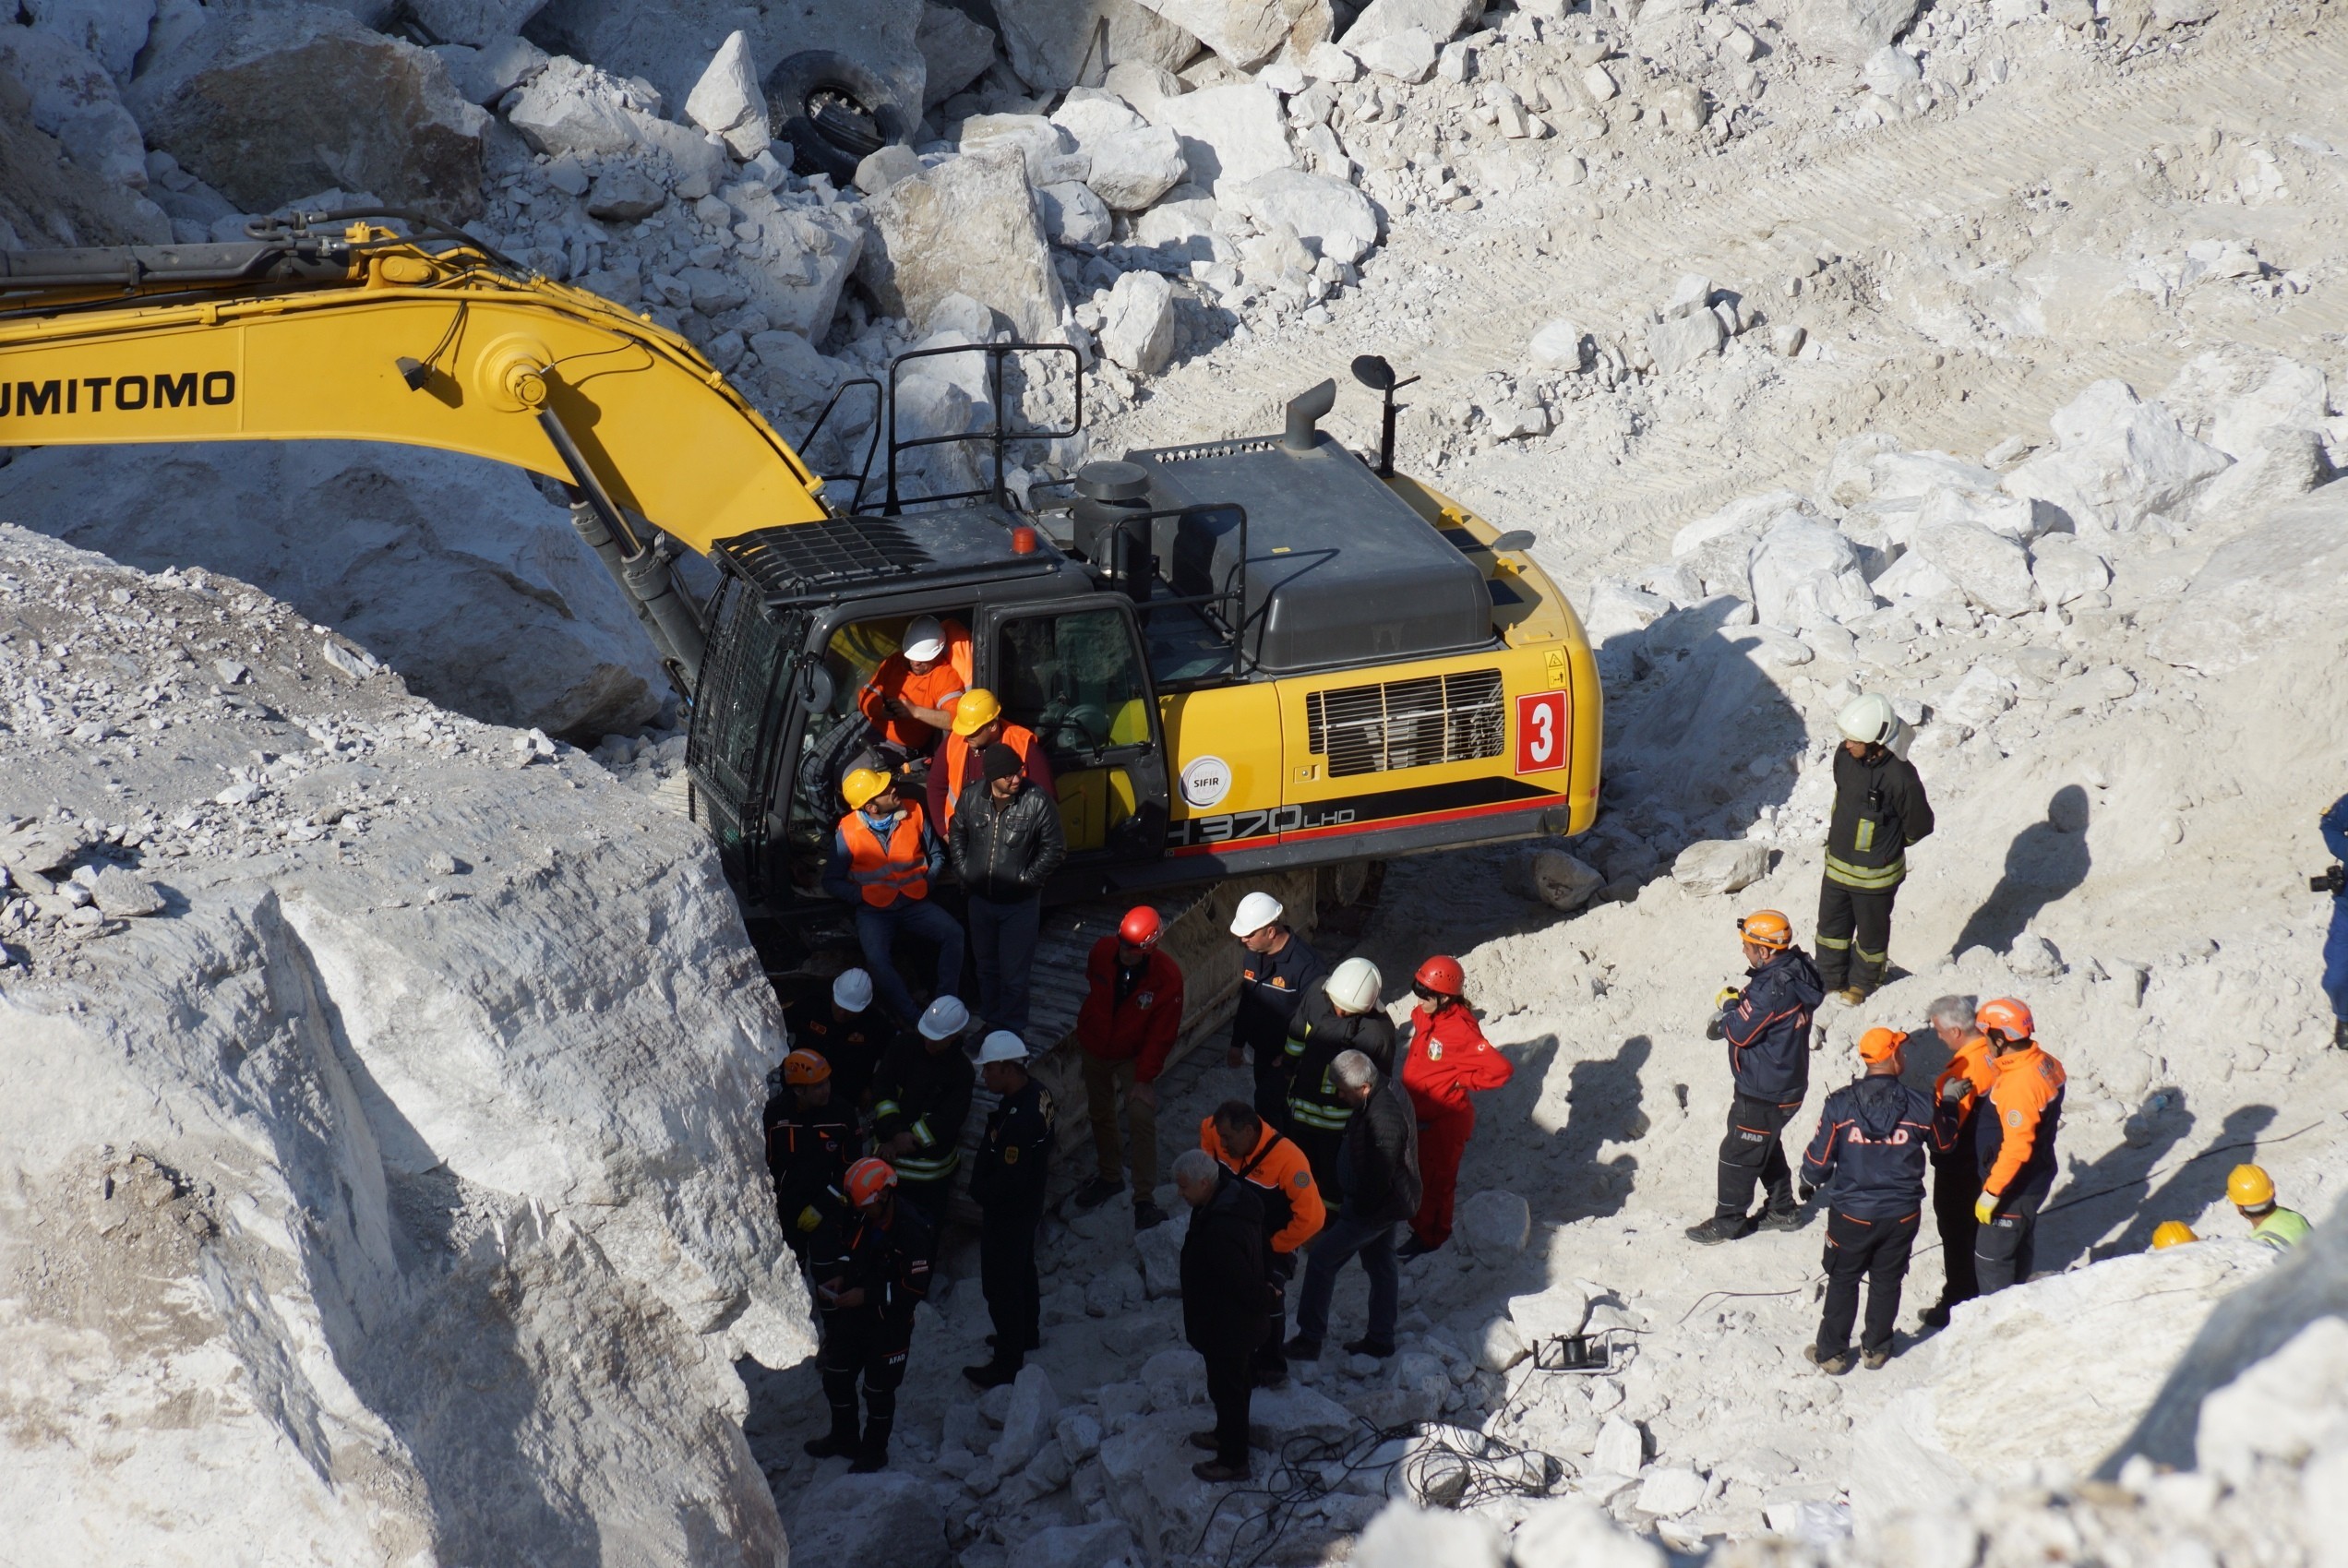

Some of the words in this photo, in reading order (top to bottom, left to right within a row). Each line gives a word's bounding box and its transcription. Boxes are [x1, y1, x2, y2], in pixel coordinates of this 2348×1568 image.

[1530, 702, 1553, 762] 3
[1193, 777, 1219, 787] SIFIR
[1741, 1131, 1763, 1143] AFAD
[1848, 1127, 1909, 1145] AD
[889, 1353, 905, 1365] AFAD
